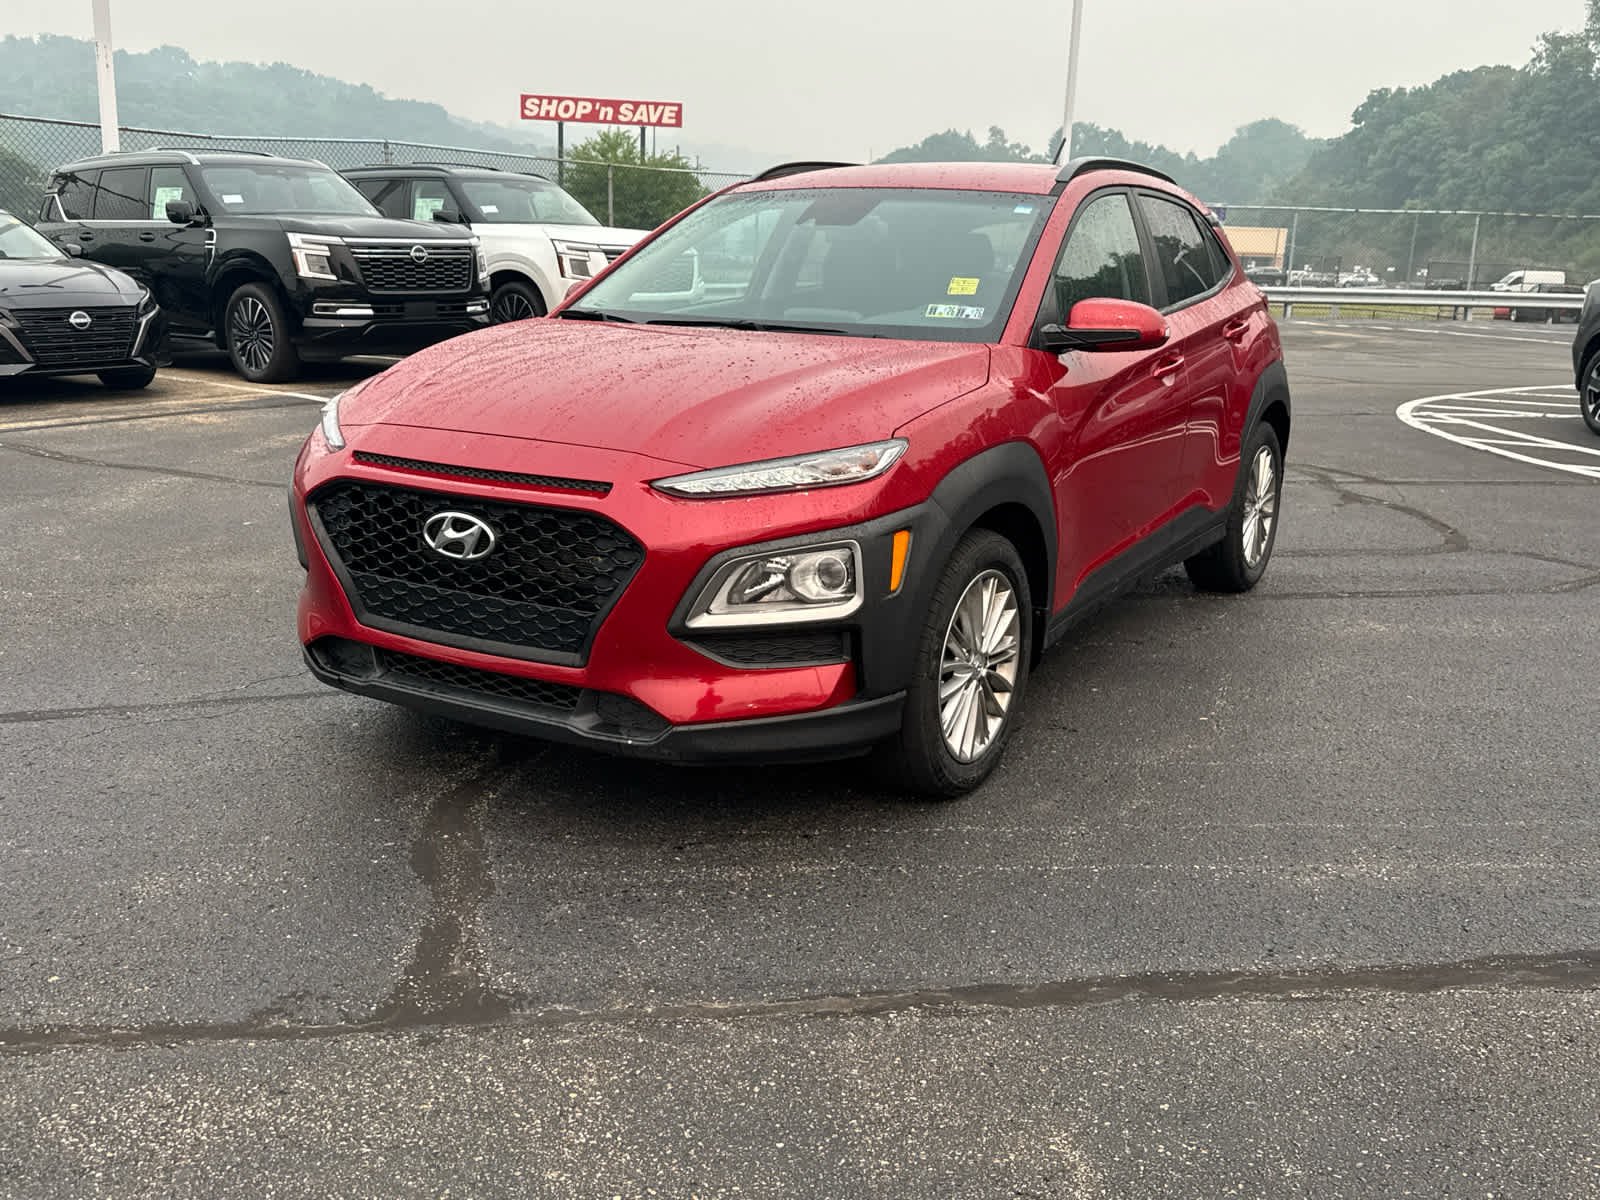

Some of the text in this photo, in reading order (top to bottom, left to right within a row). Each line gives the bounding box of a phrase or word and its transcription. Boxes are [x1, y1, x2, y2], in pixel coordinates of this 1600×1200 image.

[523, 98, 679, 124] SHOP 'n SAVE
